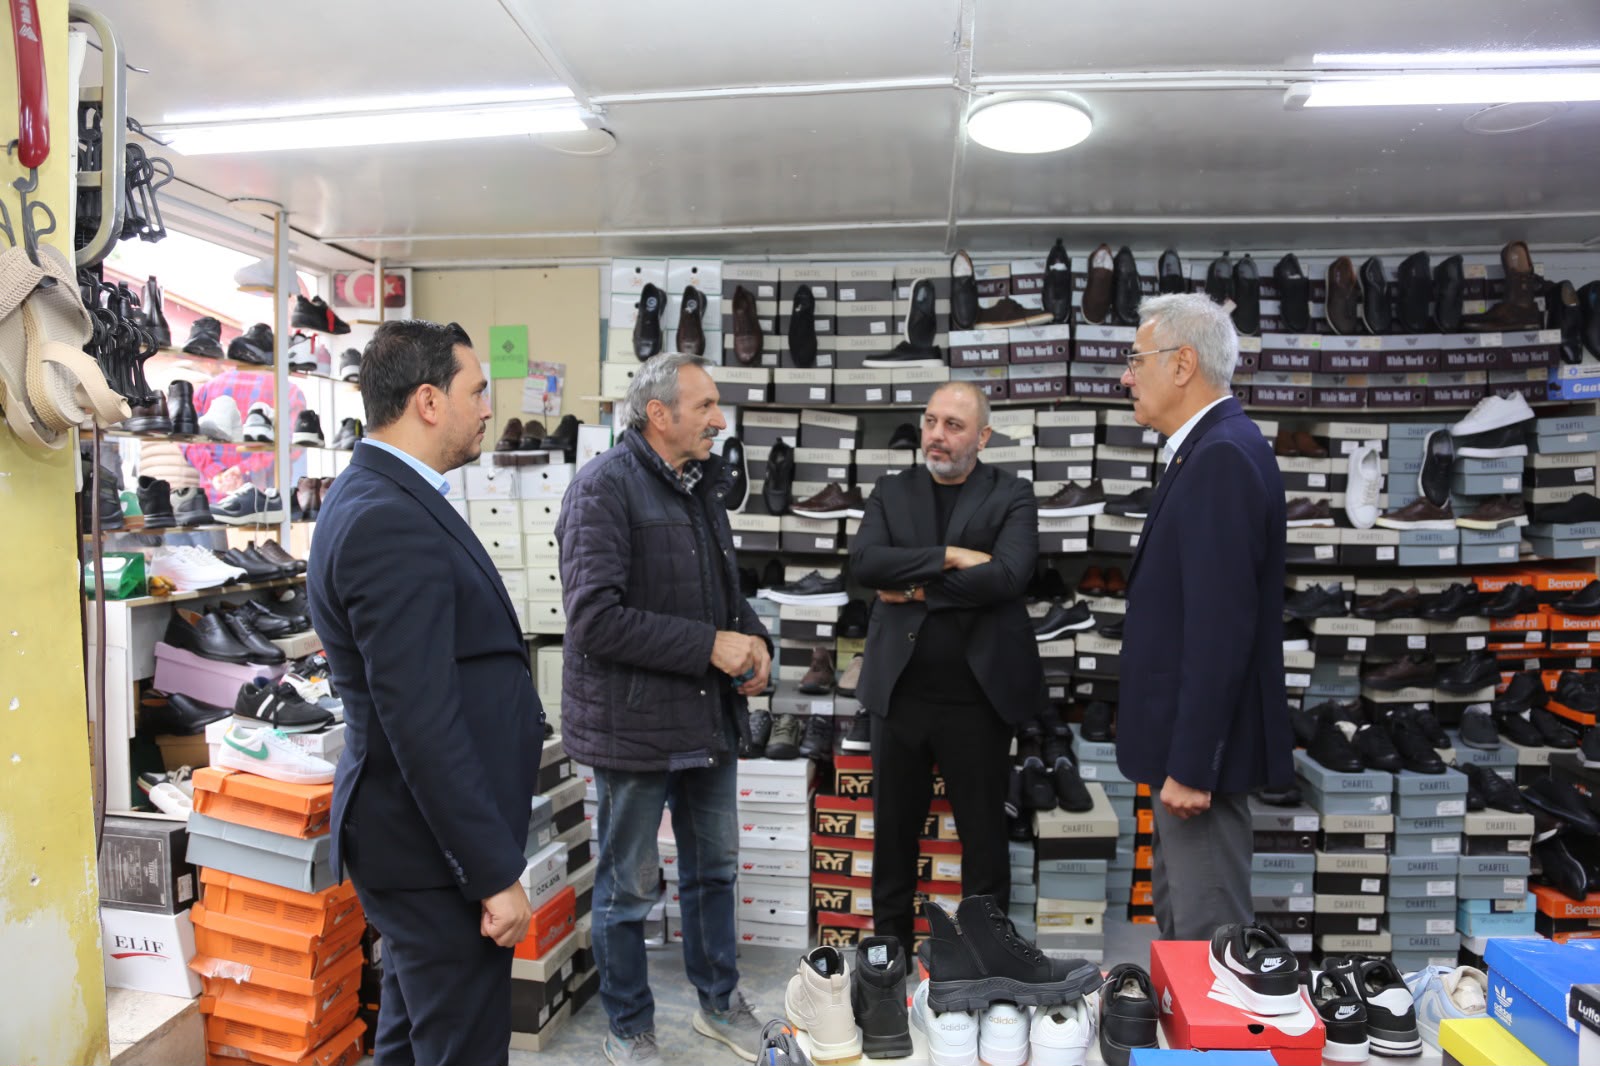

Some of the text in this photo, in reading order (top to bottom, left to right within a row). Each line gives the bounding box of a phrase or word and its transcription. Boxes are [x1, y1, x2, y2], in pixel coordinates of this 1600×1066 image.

[1342, 779, 1374, 789] CHARTEL
[1419, 780, 1451, 791] CHARTEL
[1062, 824, 1094, 834] CHARTEL
[1486, 820, 1517, 831] CHARTEL
[1263, 859, 1296, 869] CHARTEL
[1407, 860, 1439, 871] CHARTEL
[1478, 862, 1510, 873] CHARTEL
[1409, 937, 1441, 947] CHARTEL
[1264, 957, 1283, 967] NIKE
[1339, 1005, 1357, 1014] NIKE
[988, 1015, 1019, 1026] adidas
[941, 1022, 970, 1032] adidas
